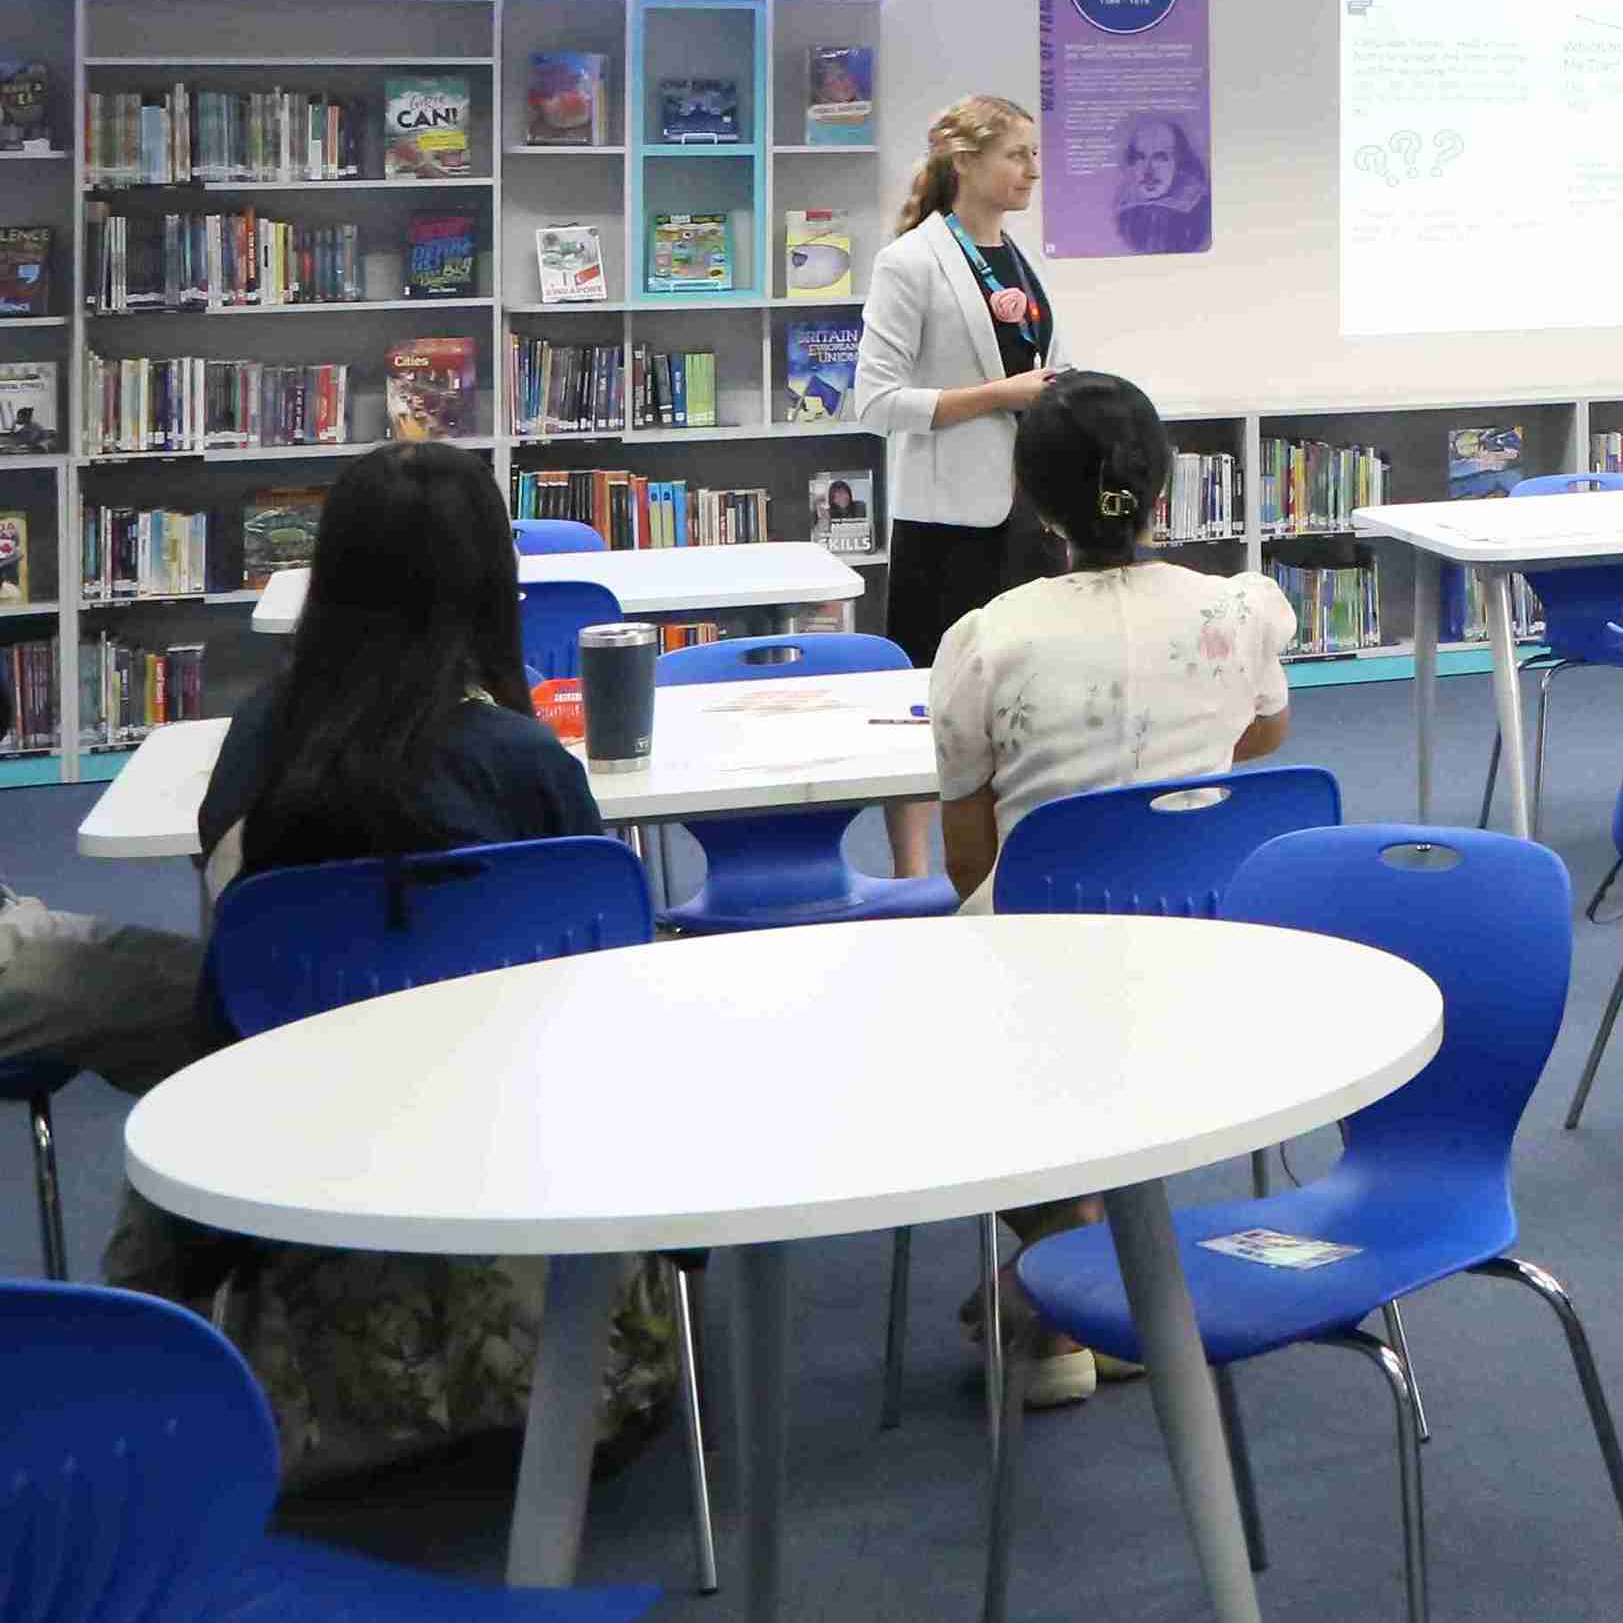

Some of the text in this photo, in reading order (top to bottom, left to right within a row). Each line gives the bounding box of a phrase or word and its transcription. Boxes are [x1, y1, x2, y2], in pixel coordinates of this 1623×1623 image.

[397, 106, 457, 128] CAN!
[799, 329, 858, 344] BRITAIN
[394, 355, 430, 368] Cities
[818, 352, 860, 363] UNION
[818, 537, 872, 551] SKILLS
